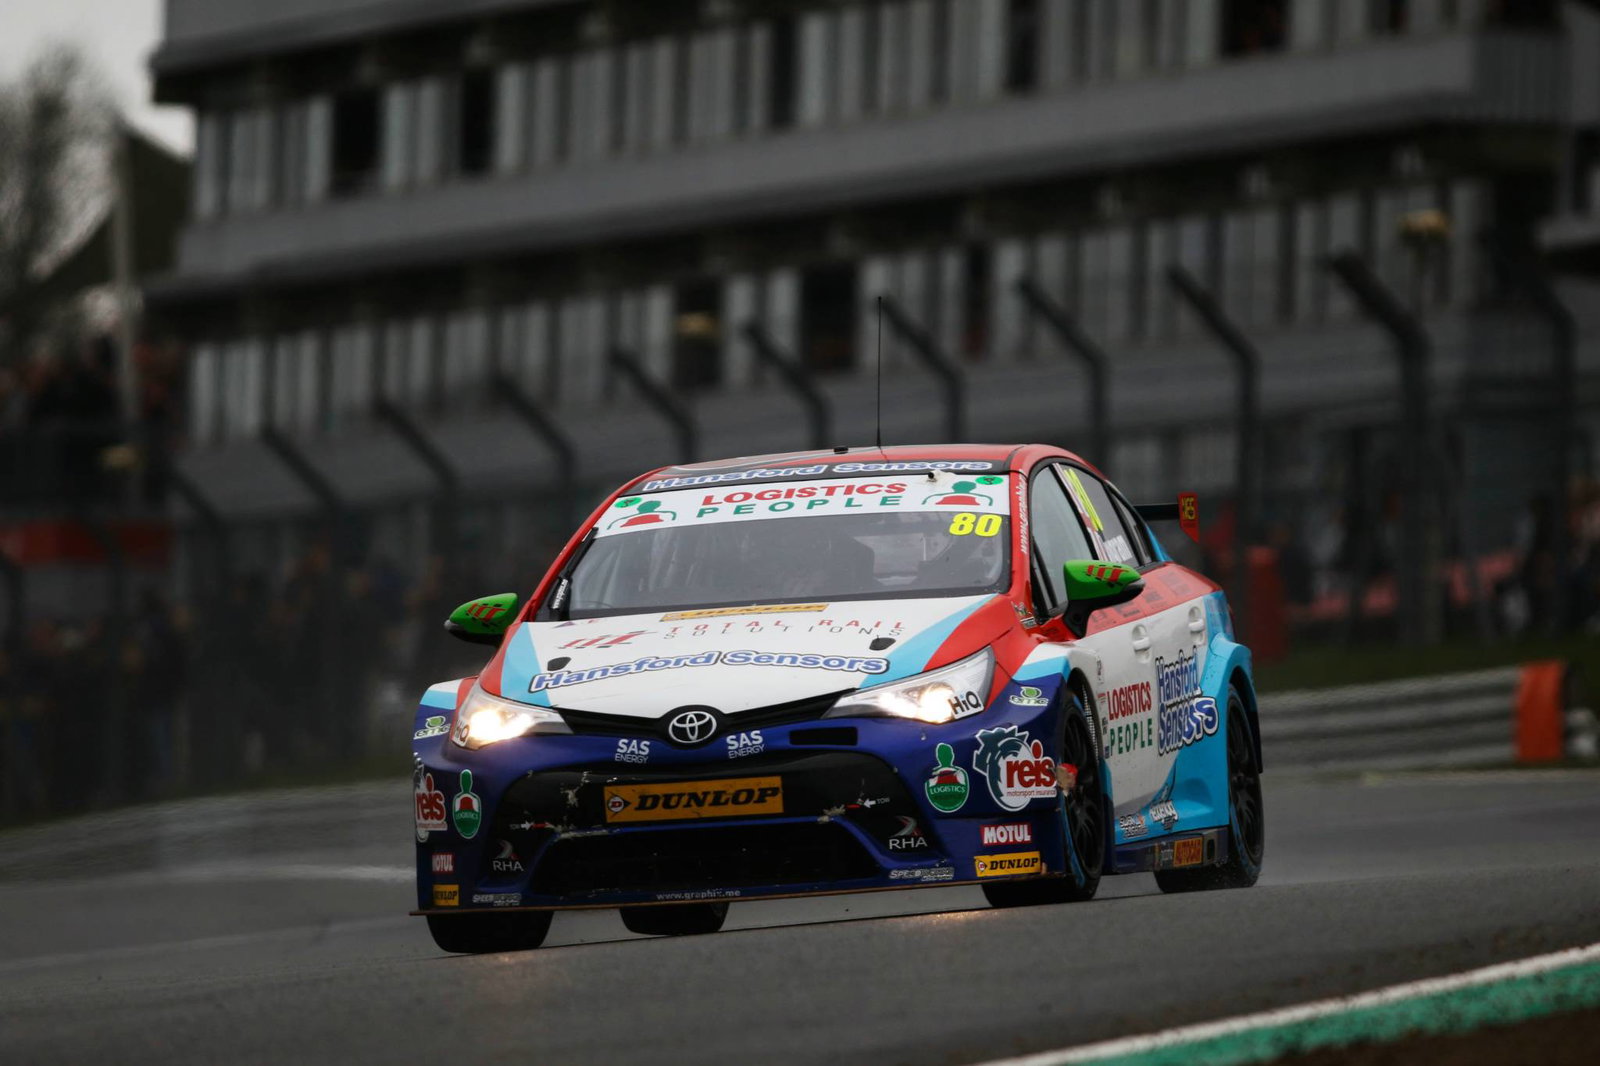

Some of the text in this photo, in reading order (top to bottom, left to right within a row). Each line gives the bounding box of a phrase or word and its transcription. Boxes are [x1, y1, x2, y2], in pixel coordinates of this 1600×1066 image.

[643, 462, 992, 492] Hansford Sensors
[702, 483, 907, 506] LOGISTICS
[696, 496, 903, 518] PEOPLE
[949, 512, 1002, 537] 80
[664, 625, 905, 640] SOLUTIONS
[671, 619, 905, 633] TOTAL RAIL
[529, 649, 889, 693] Hansford Sensors
[1156, 645, 1202, 703] Hansford
[949, 690, 982, 715] HiQ
[1107, 681, 1152, 720] LOGISTICS
[1110, 718, 1153, 756] PEOPLE
[1158, 697, 1218, 756] Sensors
[617, 739, 650, 755] SAS
[726, 730, 763, 750] SAS
[615, 753, 649, 764] ENERGY
[728, 744, 765, 759] ENERGY
[1006, 742, 1056, 788] reis
[634, 787, 780, 811] DUNLOP
[930, 785, 966, 795] LOGISTICS
[888, 837, 928, 849] RHA
[983, 824, 1031, 844] MOTUL
[493, 860, 524, 871] RHA
[990, 858, 1038, 871] DUNLOP
